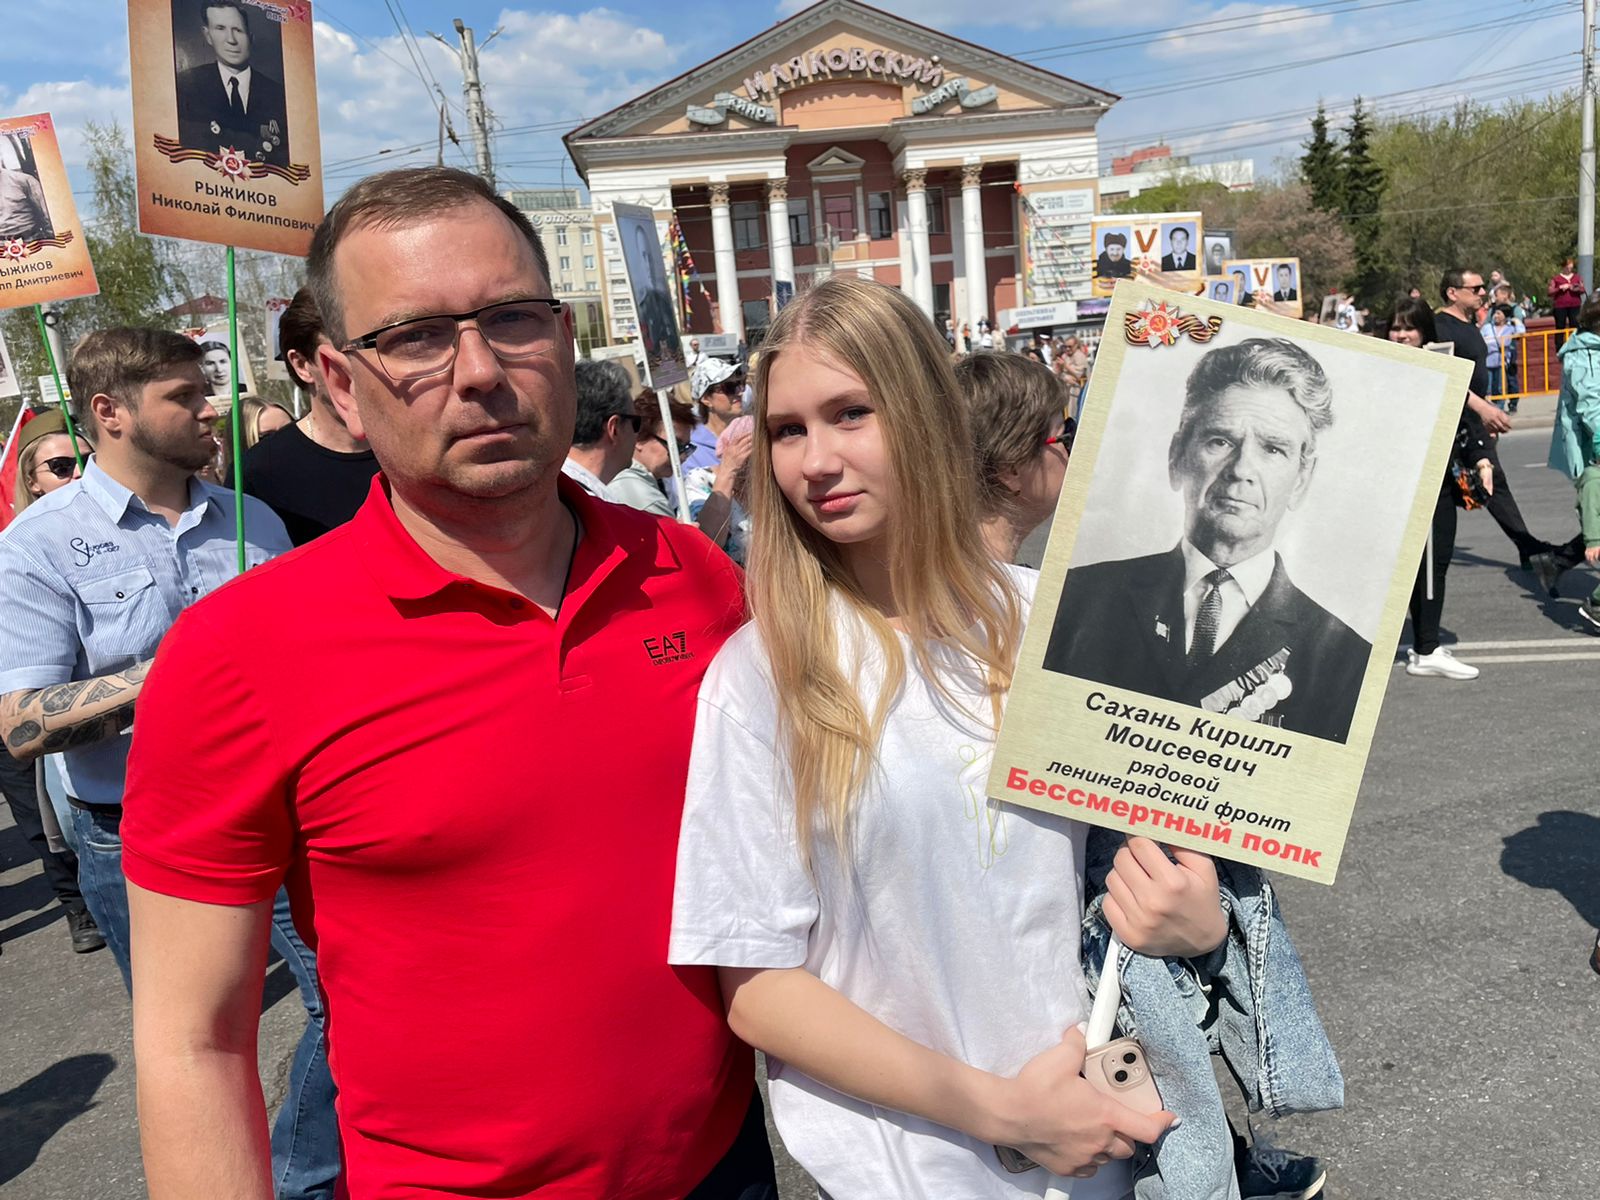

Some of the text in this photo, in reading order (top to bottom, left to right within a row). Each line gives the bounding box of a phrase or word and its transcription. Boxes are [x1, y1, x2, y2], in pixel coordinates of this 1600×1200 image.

[743, 48, 944, 100] МАЯКОВСКИЙ
[728, 98, 766, 118] КИНО
[921, 79, 961, 111] ТЕАТР
[152, 193, 315, 232] Николай Филиппович
[195, 181, 277, 207] РЫЖИКОВ
[15, 270, 83, 289] Дмитриевич
[643, 631, 686, 659] EA7
[1085, 691, 1292, 759] Сахань Кирилл
[1105, 722, 1257, 777] Моисеевич
[1126, 758, 1221, 793] рядовой
[1046, 759, 1292, 833] ленинградский фронт
[1006, 767, 1322, 868] Бессмертный полк
